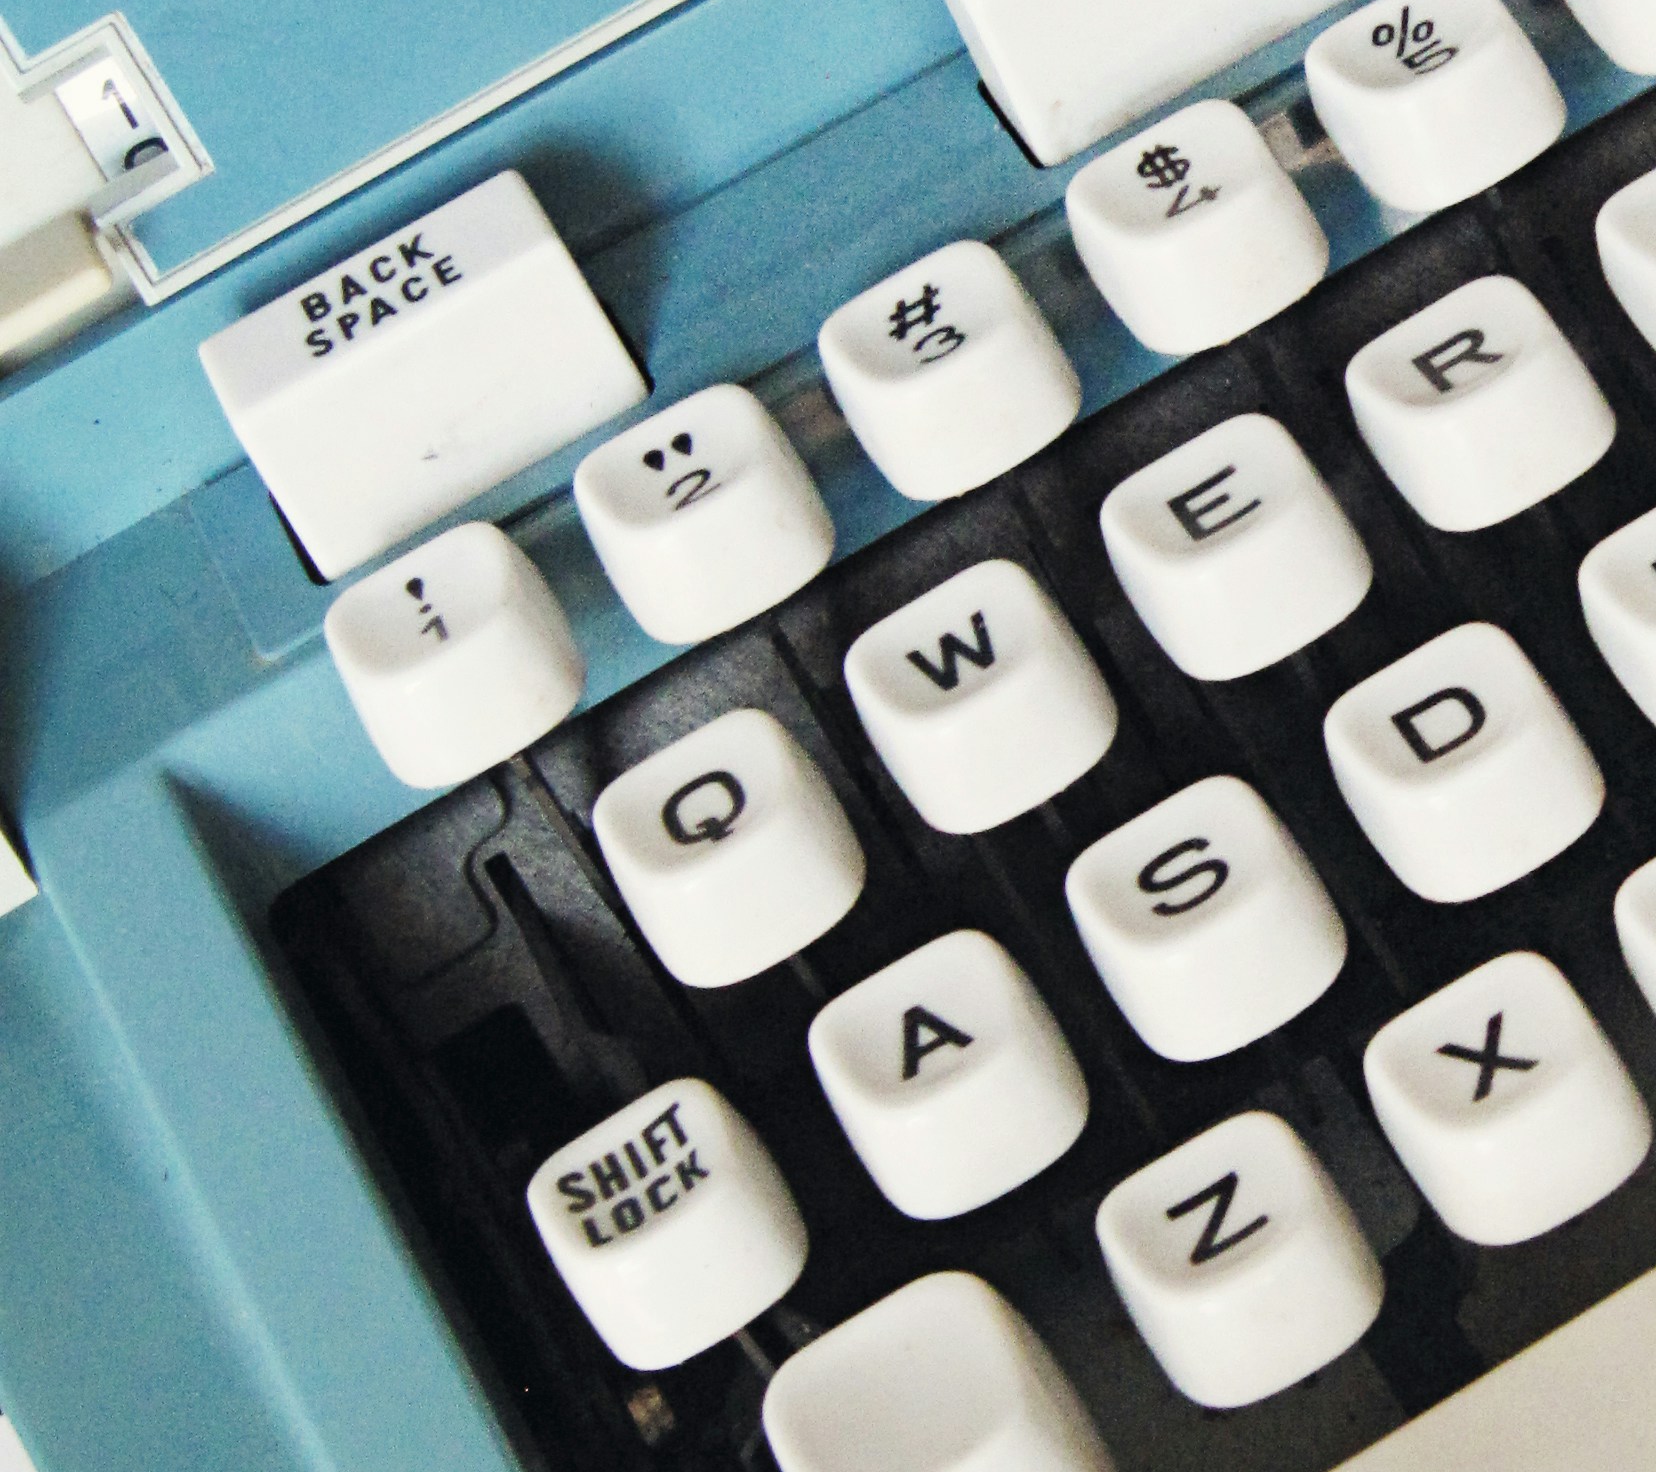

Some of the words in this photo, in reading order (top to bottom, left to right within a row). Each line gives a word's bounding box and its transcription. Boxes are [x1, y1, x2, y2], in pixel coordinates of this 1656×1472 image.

[300, 232, 436, 323] BACK
[304, 255, 464, 359] SPACE
[1411, 329, 1504, 395] R
[1166, 466, 1262, 542] E
[905, 611, 996, 692] W
[1390, 687, 1486, 764] D
[661, 770, 746, 846] Q
[1137, 837, 1229, 917] S
[901, 1005, 974, 1081] A
[1436, 1012, 1538, 1102] X
[555, 1102, 691, 1216] SHIFT
[580, 1157, 711, 1249] LOCK
[1165, 1171, 1269, 1266] Z
